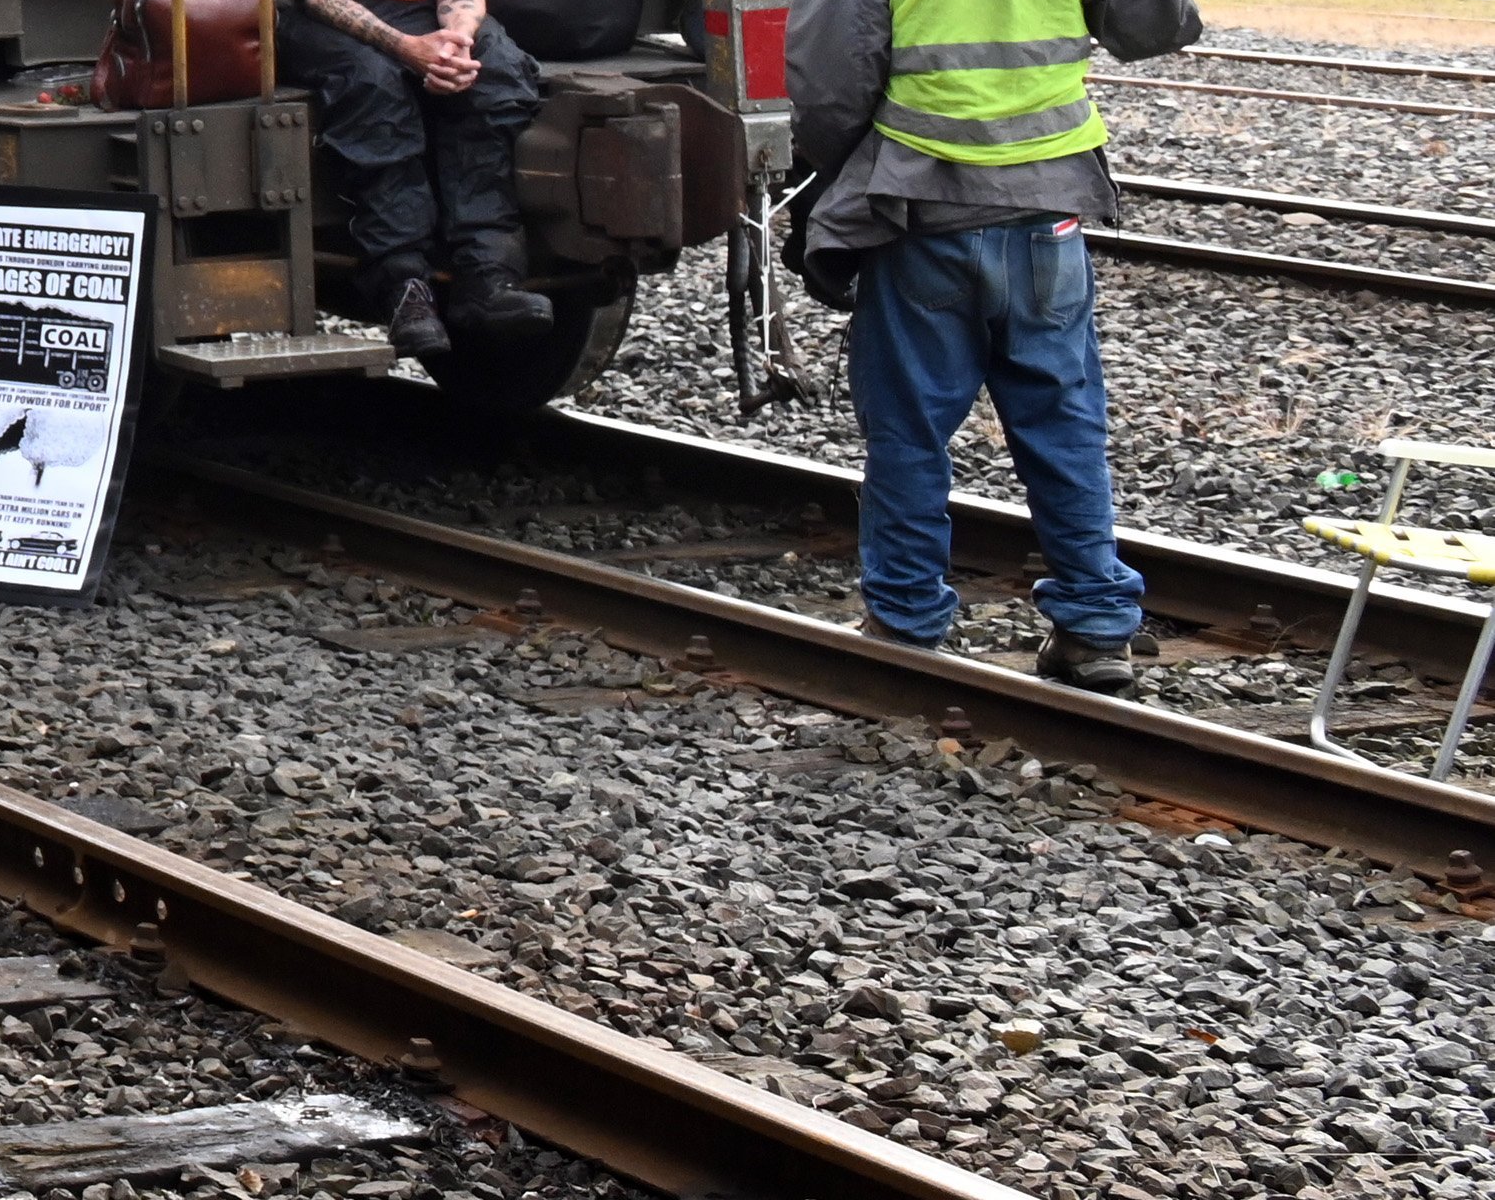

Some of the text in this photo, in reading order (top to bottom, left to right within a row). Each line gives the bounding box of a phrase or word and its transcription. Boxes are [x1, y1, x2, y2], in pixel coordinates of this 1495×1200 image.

[24, 230, 130, 257] EMERGENCY!
[5, 255, 35, 264] THROUGH
[36, 258, 64, 267] DUNEDIN
[66, 260, 99, 269] CARRYING
[101, 263, 128, 272] AROUND
[45, 273, 71, 296] OF
[73, 274, 124, 301] COAL
[44, 327, 102, 349] COAL
[14, 395, 52, 407] POWDER
[54, 398, 71, 408] FOR
[73, 401, 107, 412] EXPORT
[12, 516, 34, 525] KEEPS
[21, 506, 49, 515] MILLION
[51, 509, 70, 518] CARS
[5, 552, 37, 569] AIN'T
[37, 556, 68, 572] COOL
